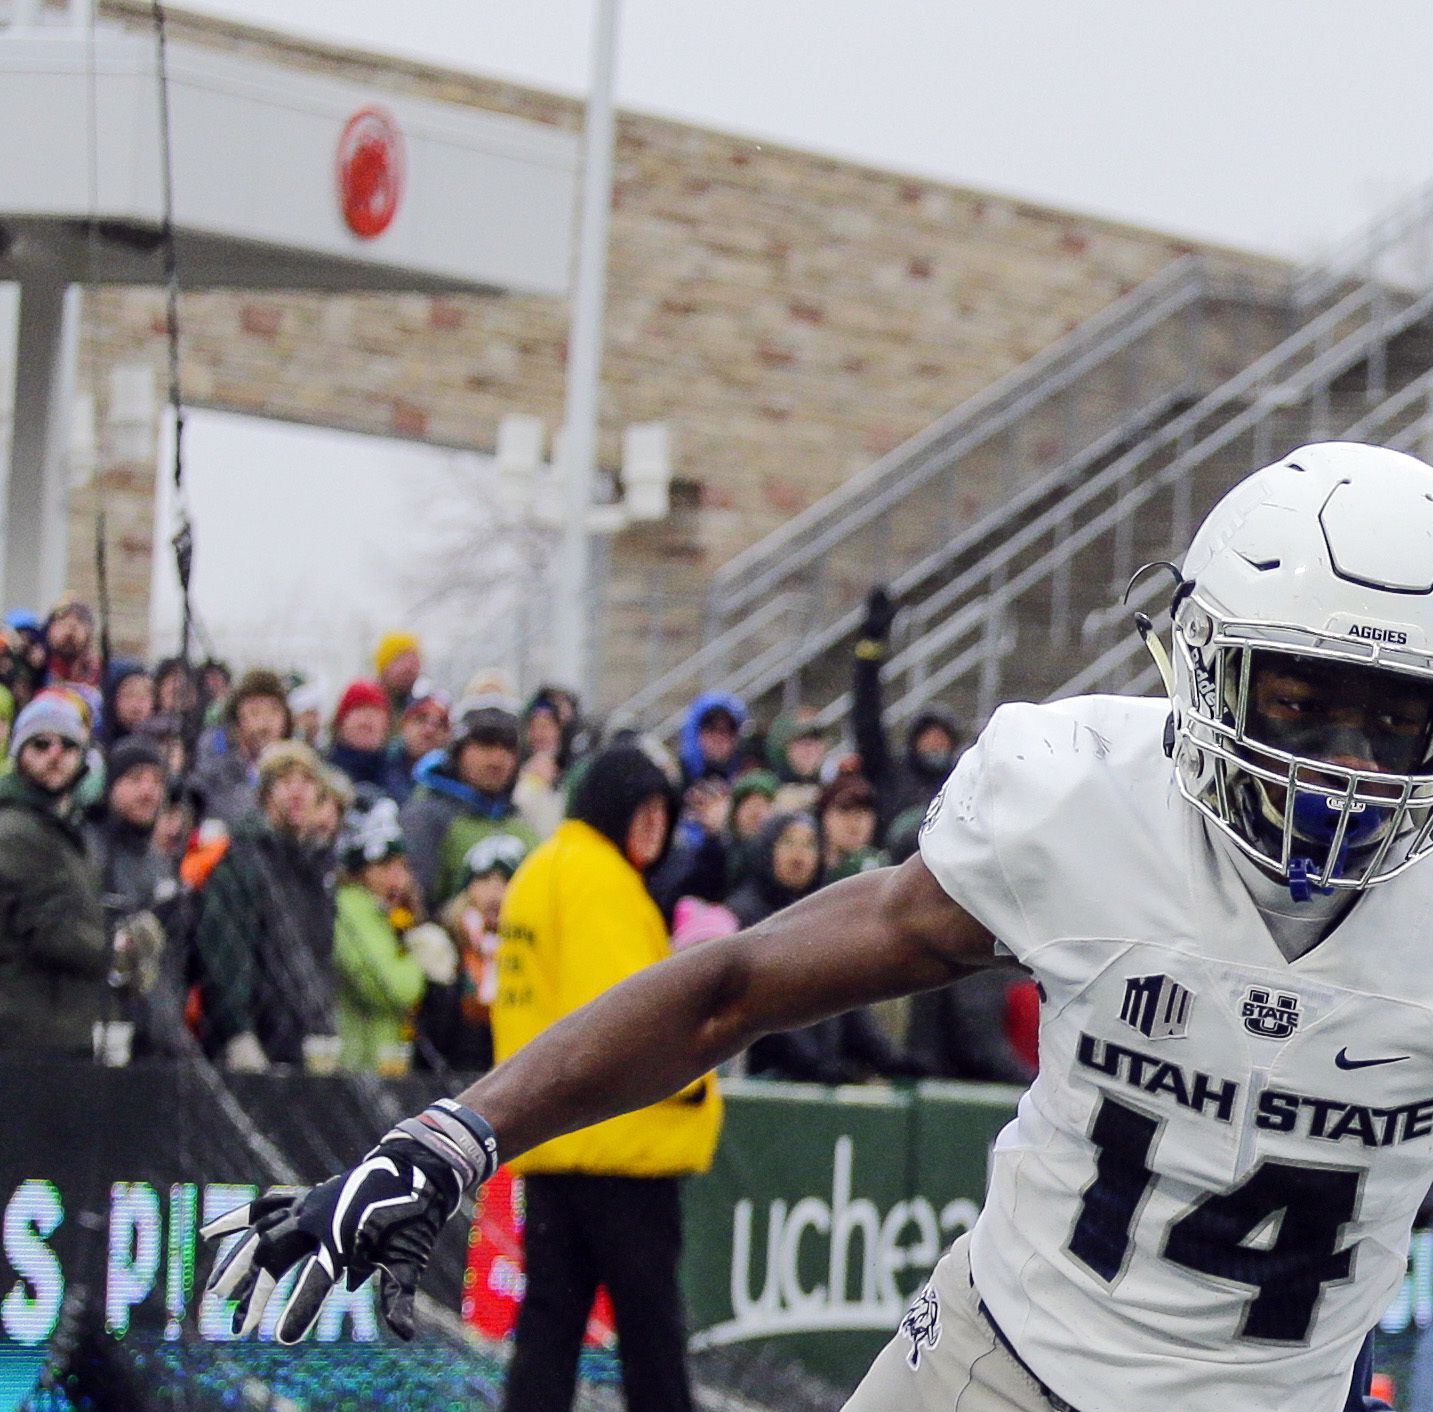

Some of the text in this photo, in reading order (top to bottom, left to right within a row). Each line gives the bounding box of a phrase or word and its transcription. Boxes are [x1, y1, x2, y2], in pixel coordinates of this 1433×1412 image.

[1348, 624, 1408, 645] AGGIES
[1242, 1001, 1300, 1028] STATE
[1076, 1030, 1239, 1124] UTAH
[1062, 1094, 1368, 1346] 14
